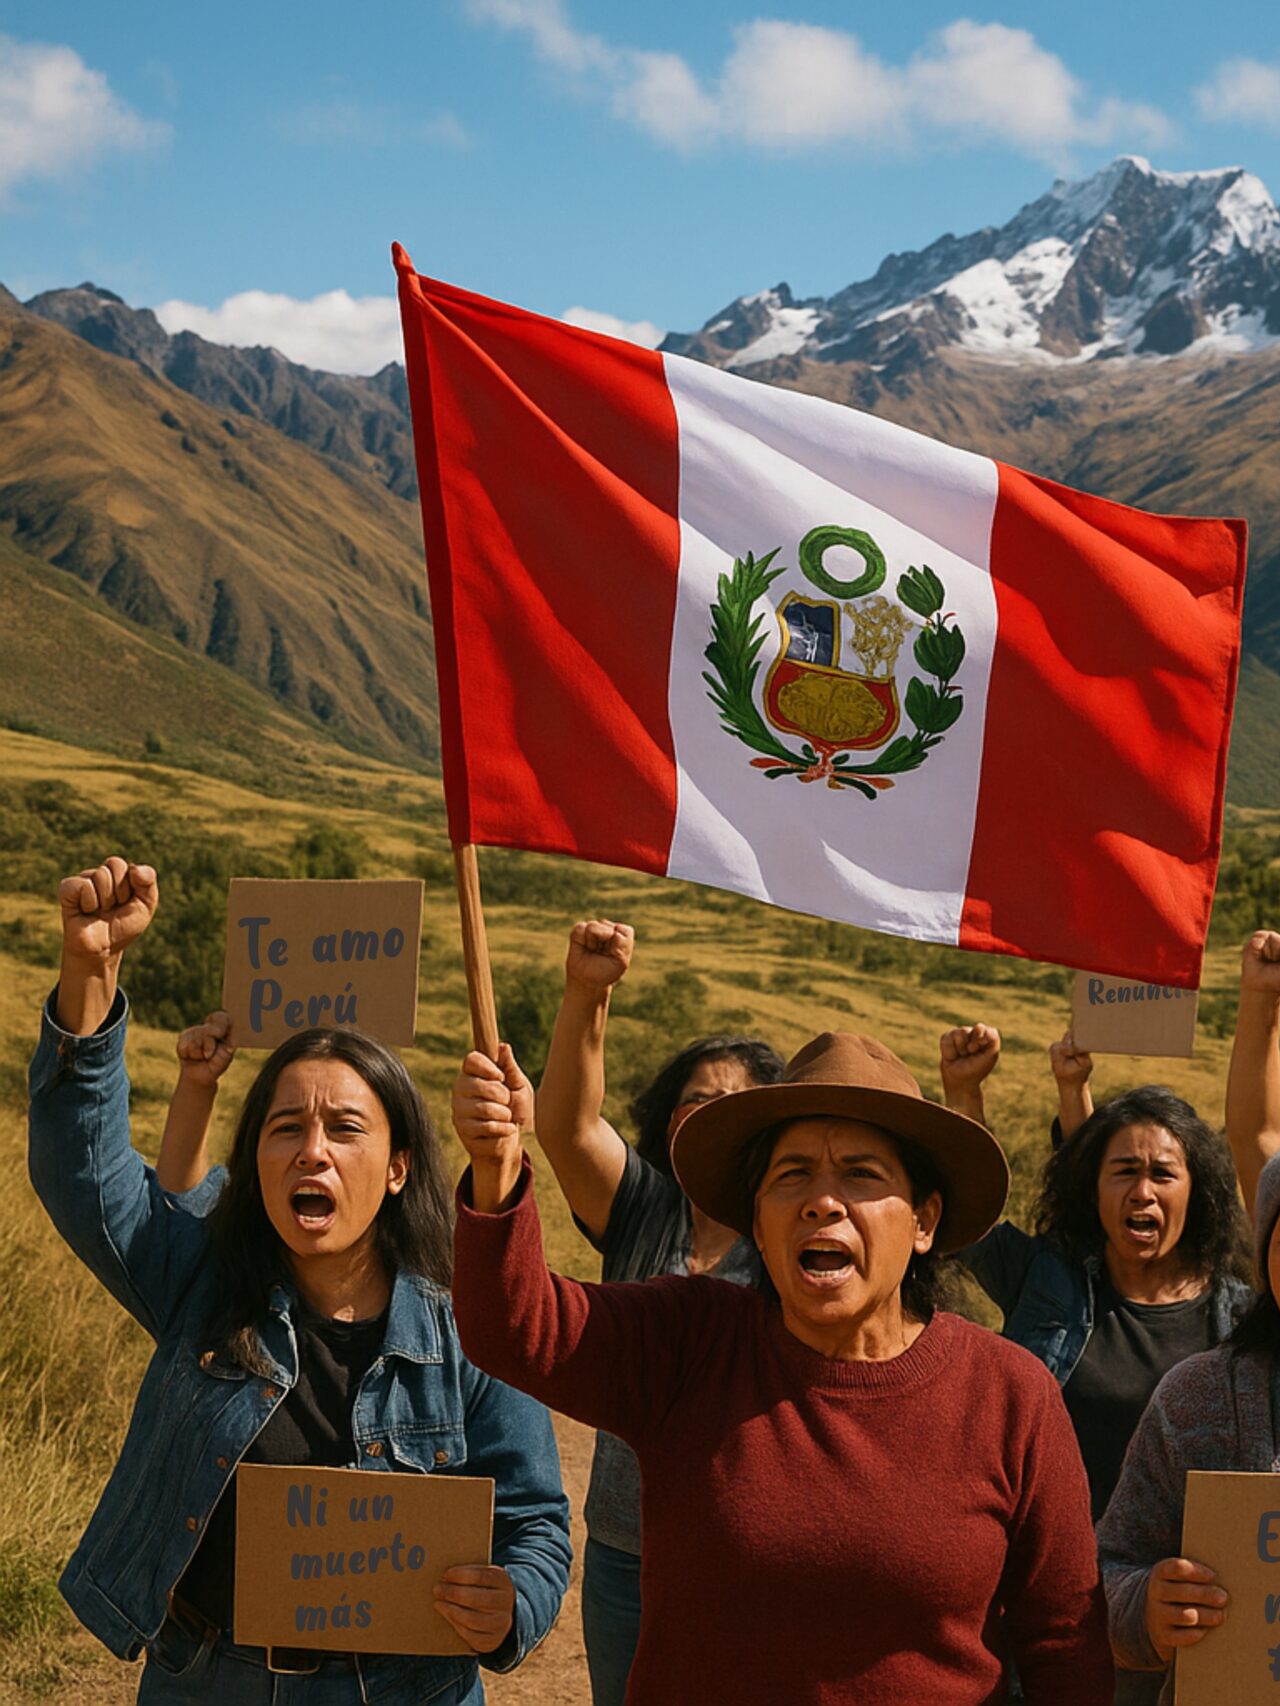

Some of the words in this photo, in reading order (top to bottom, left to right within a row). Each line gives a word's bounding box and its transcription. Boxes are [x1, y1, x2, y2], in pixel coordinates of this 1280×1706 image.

[237, 916, 289, 970] Te
[312, 927, 405, 963] amo
[249, 978, 358, 1034] Perú
[286, 1483, 329, 1528] Ni
[349, 1494, 395, 1523] un
[290, 1532, 426, 1581] muerto
[294, 1592, 374, 1633] más
